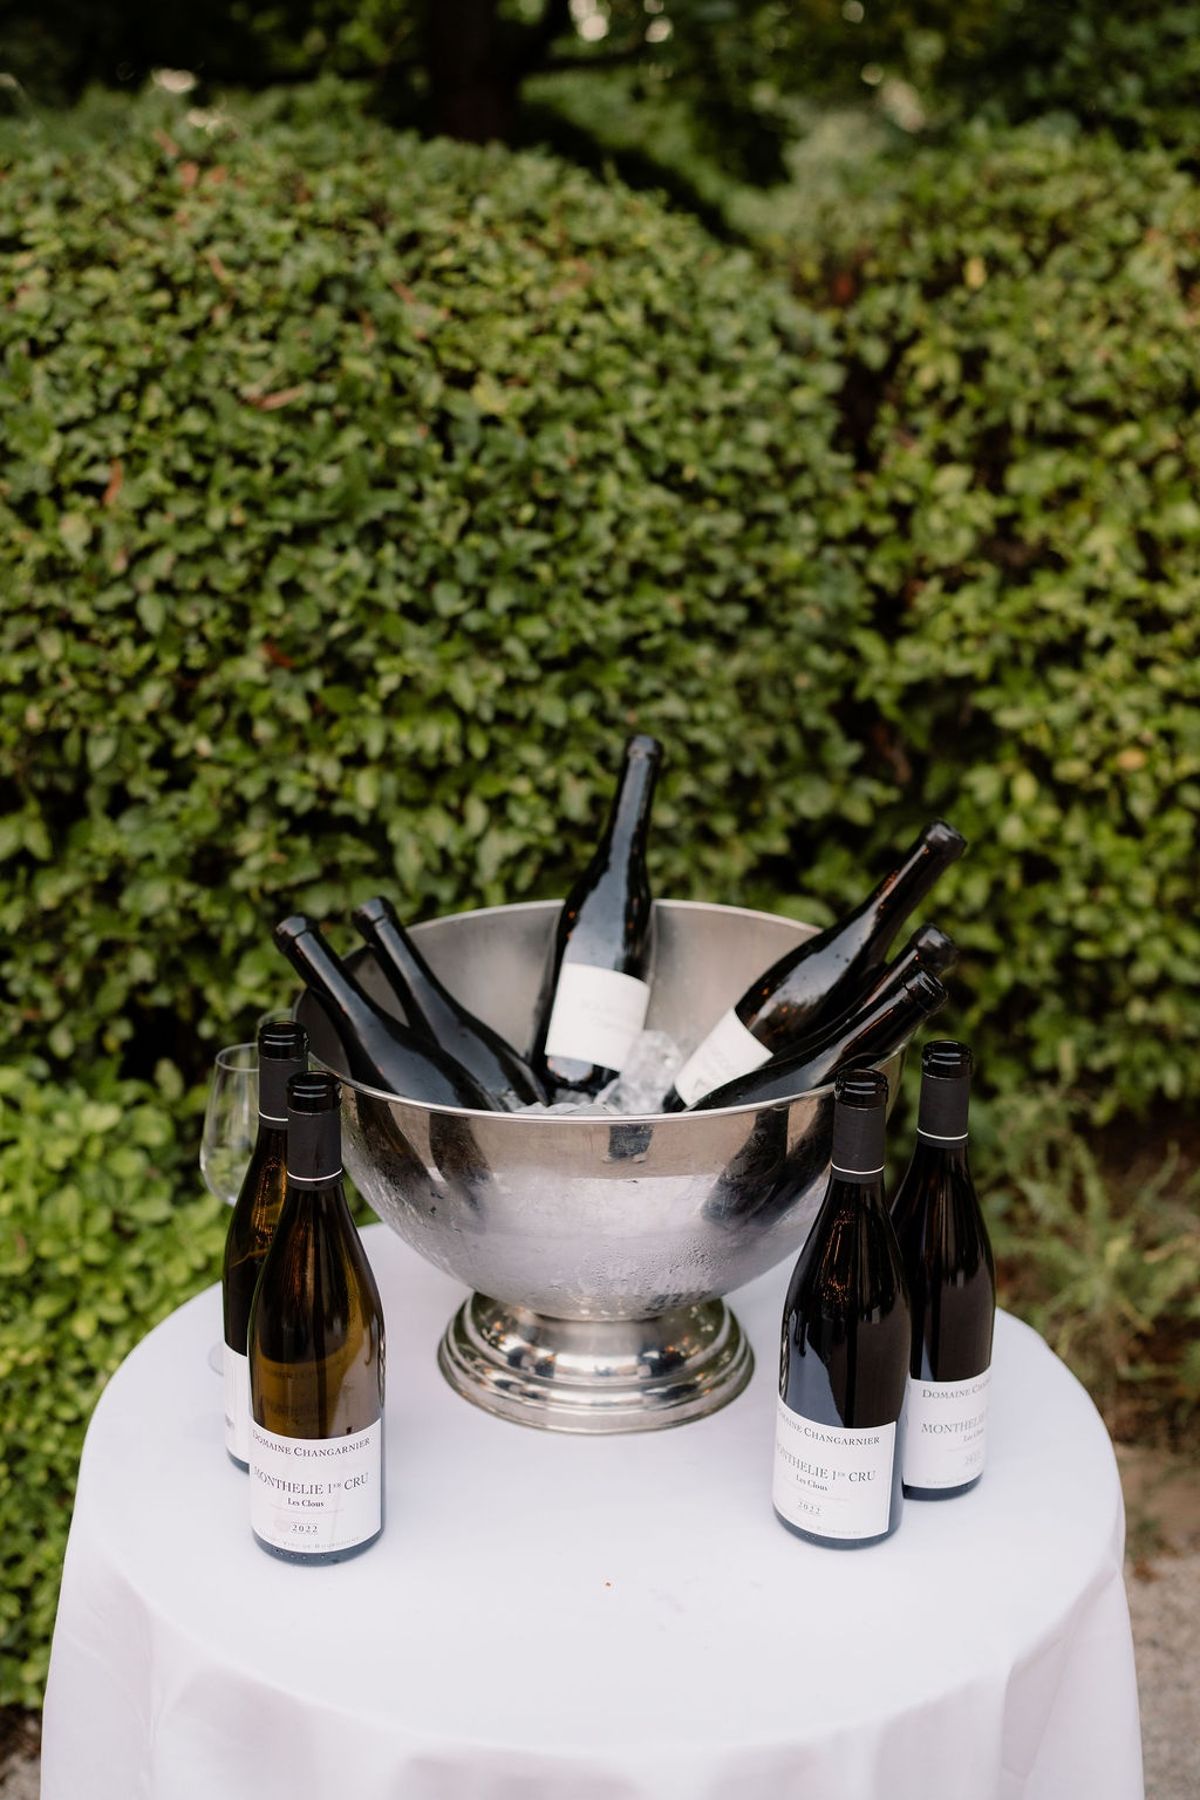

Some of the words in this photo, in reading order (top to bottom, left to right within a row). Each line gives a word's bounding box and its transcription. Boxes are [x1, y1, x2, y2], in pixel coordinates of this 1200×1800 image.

[922, 1388, 970, 1400] DOMAINE
[804, 1427, 880, 1446] CHANGARNIER
[252, 1429, 292, 1455] DOMAINE
[293, 1437, 370, 1458] CHANGARNIER
[344, 1472, 369, 1491] CRU
[848, 1469, 877, 1482] CRU
[287, 1497, 300, 1506] Les
[799, 1501, 820, 1515] 2022
[292, 1524, 318, 1533] 2022
